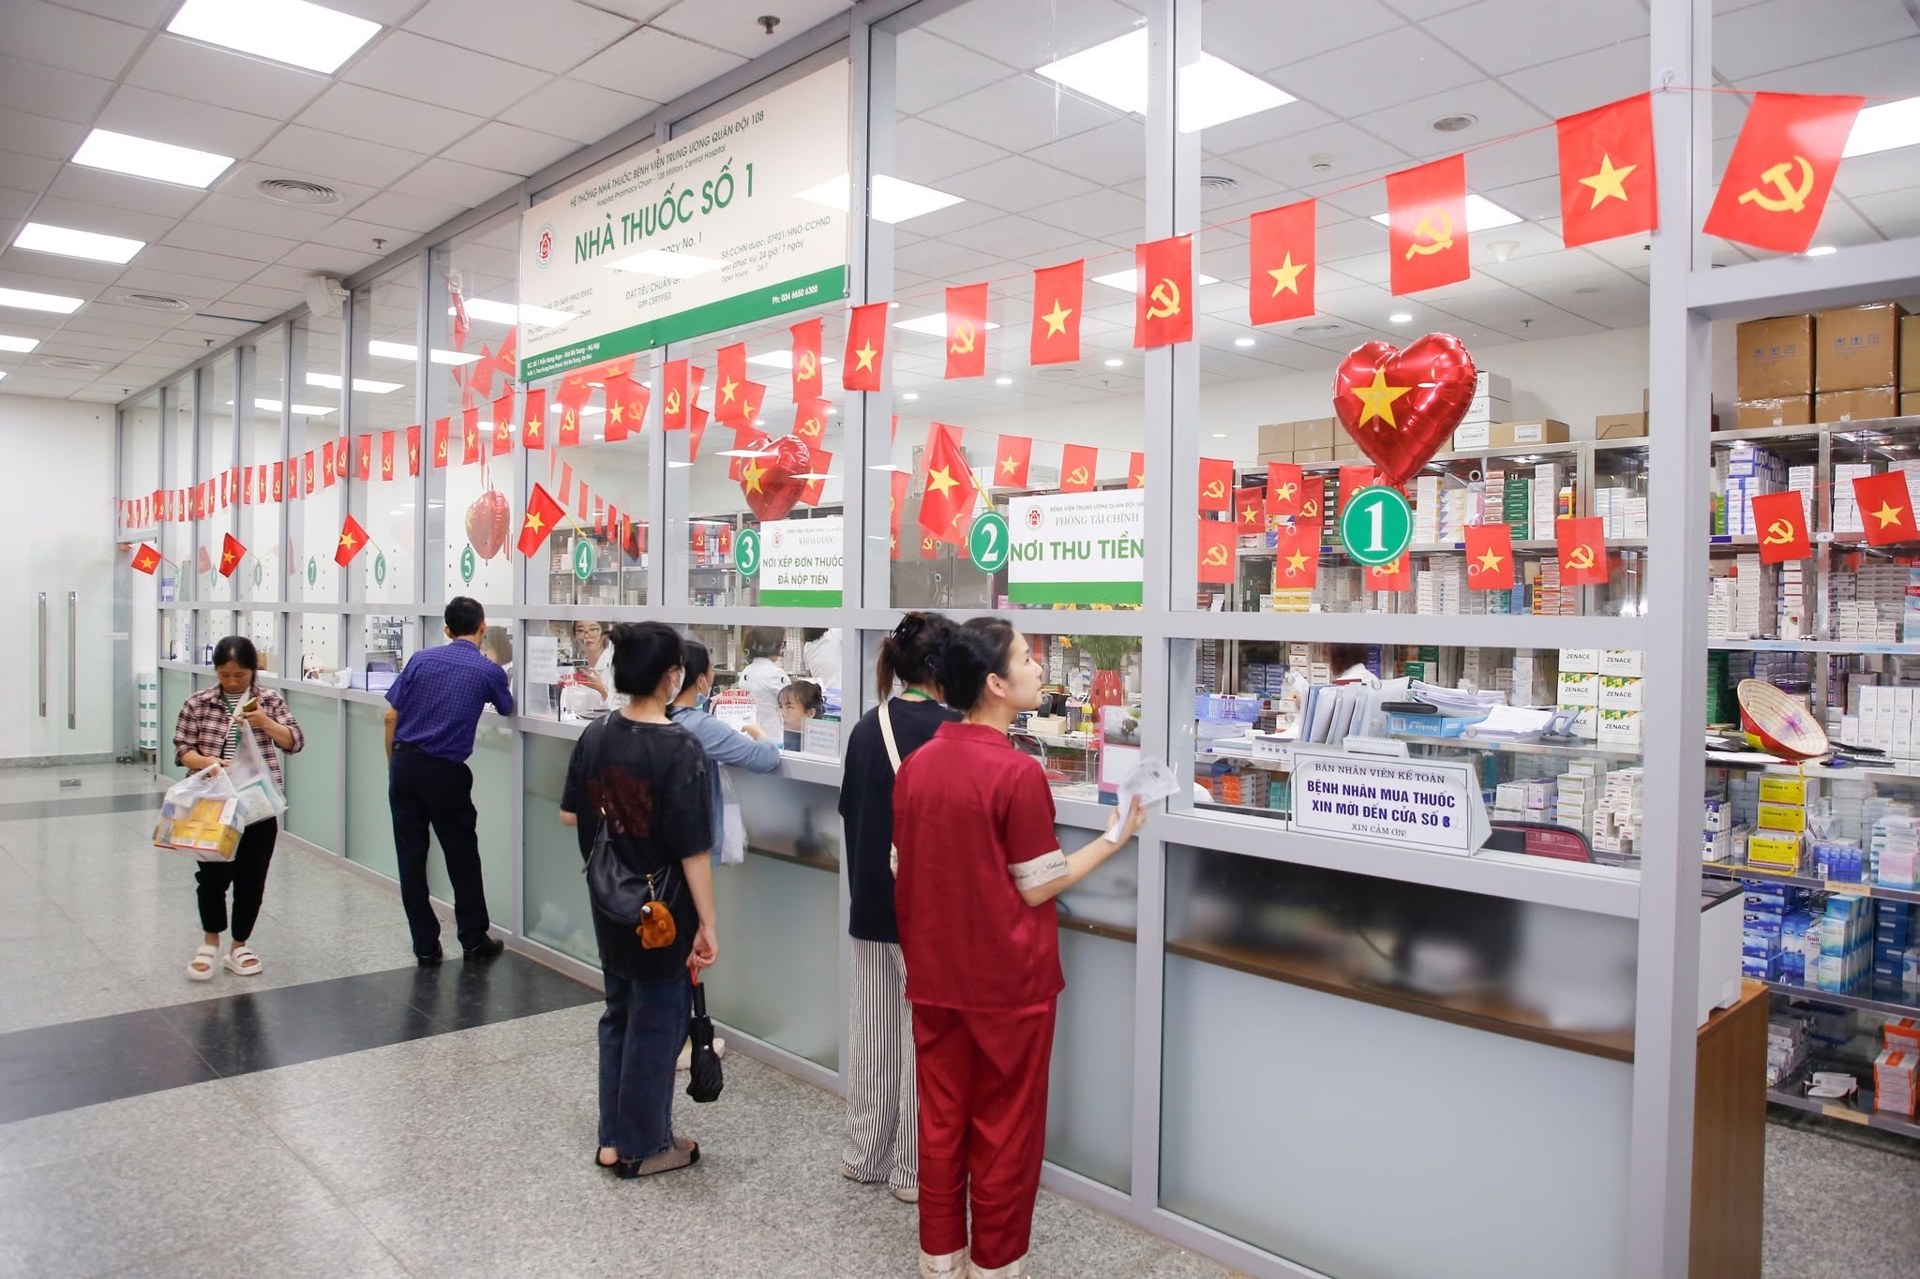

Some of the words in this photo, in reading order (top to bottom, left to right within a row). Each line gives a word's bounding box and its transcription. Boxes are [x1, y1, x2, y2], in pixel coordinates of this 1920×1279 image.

[598, 179, 610, 195] NHÀ
[612, 171, 632, 188] THUỐC
[634, 164, 649, 180] BỆNH
[650, 156, 664, 172] VIỆN
[666, 146, 688, 162] TRUNG
[712, 124, 734, 142] QUÂN
[735, 117, 749, 132] ĐỘI
[752, 110, 764, 124] 108
[684, 155, 704, 168] Central
[704, 144, 726, 158] Hospital
[575, 213, 615, 264] NHÀ
[621, 182, 694, 246] THUỐC
[701, 156, 734, 214] SỐ
[746, 163, 753, 198] 1
[682, 237, 696, 250] No.
[759, 250, 766, 260] 24
[787, 240, 804, 252] ngày
[781, 292, 790, 302] 024
[804, 284, 818, 296] 6300
[1056, 515, 1088, 526] PHÒNG
[1091, 514, 1106, 525] TÀI
[1106, 512, 1139, 523] CHÍNH
[1364, 500, 1388, 552] 1
[742, 536, 754, 568] 3
[980, 524, 999, 562] 2
[1010, 540, 1043, 561] NƠI
[1050, 541, 1090, 560] THU
[1098, 530, 1144, 560] TIỀN
[310, 564, 314, 578] 7
[377, 560, 384, 579] 6
[464, 553, 472, 576] 5
[578, 546, 588, 573] 4
[762, 556, 776, 568] NƠI
[778, 554, 793, 568] XẾP
[794, 556, 812, 568] ĐƠN
[814, 552, 844, 567] THUỐC
[1338, 764, 1366, 776] NHÂN
[1370, 767, 1395, 779] VIÊN
[1398, 769, 1413, 781] KẾ
[1308, 780, 1339, 796] BỆNH
[1342, 784, 1376, 800] NHÂN
[1380, 788, 1409, 803] MUA
[1413, 791, 1455, 808] THUỐC
[1312, 800, 1332, 813] XIN
[1336, 801, 1359, 816] MỜI
[1362, 803, 1388, 820] ĐẾN
[1392, 806, 1417, 824] CỬA
[1421, 810, 1438, 826] SỐ
[1352, 823, 1368, 832] XIN
